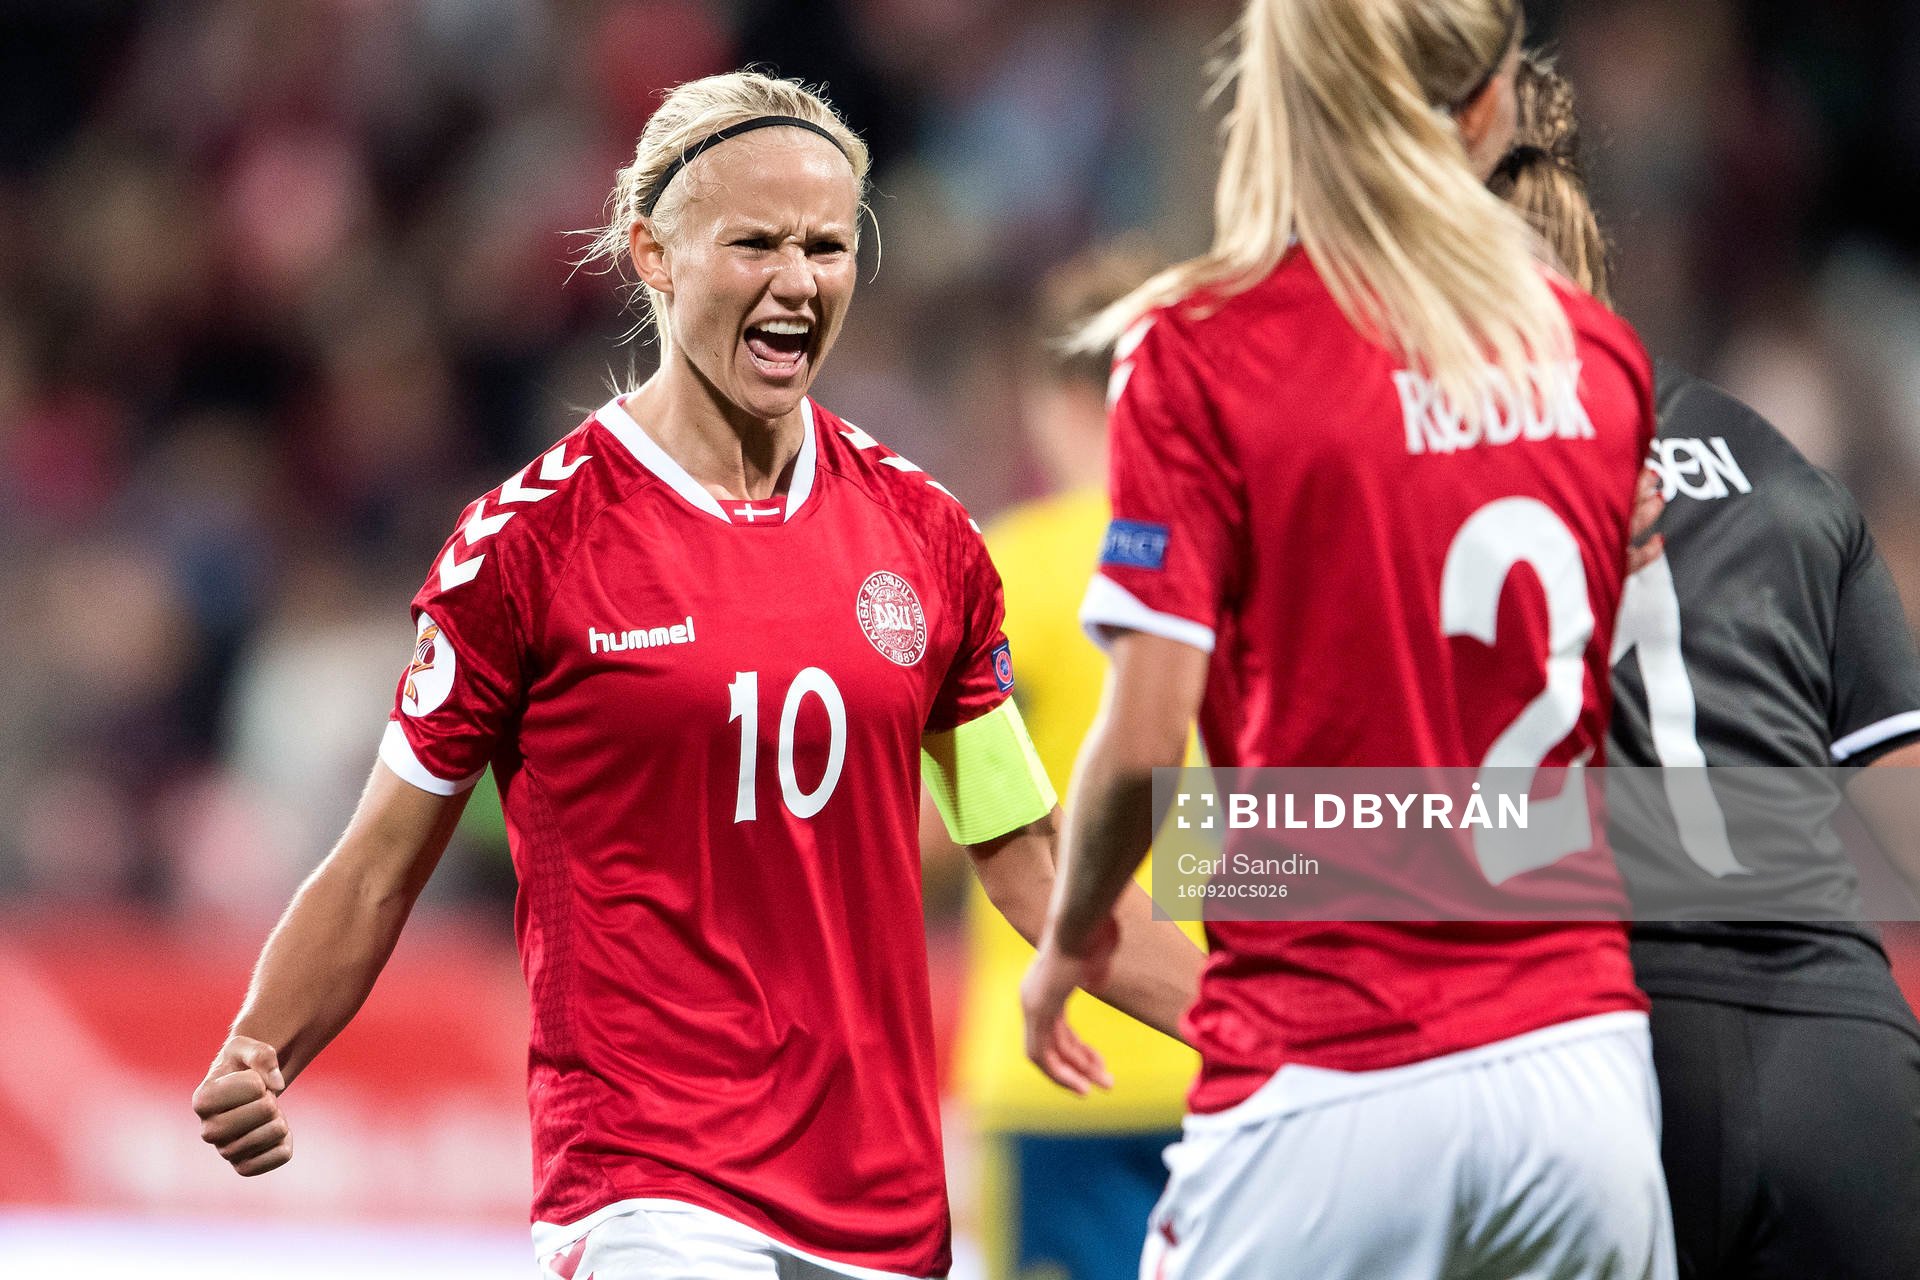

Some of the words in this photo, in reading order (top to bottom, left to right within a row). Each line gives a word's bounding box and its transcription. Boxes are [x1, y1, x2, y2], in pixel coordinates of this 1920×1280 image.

[588, 616, 696, 654] hummel
[871, 602, 914, 630] DBU
[1440, 496, 1595, 887] 2
[727, 666, 847, 823] 10
